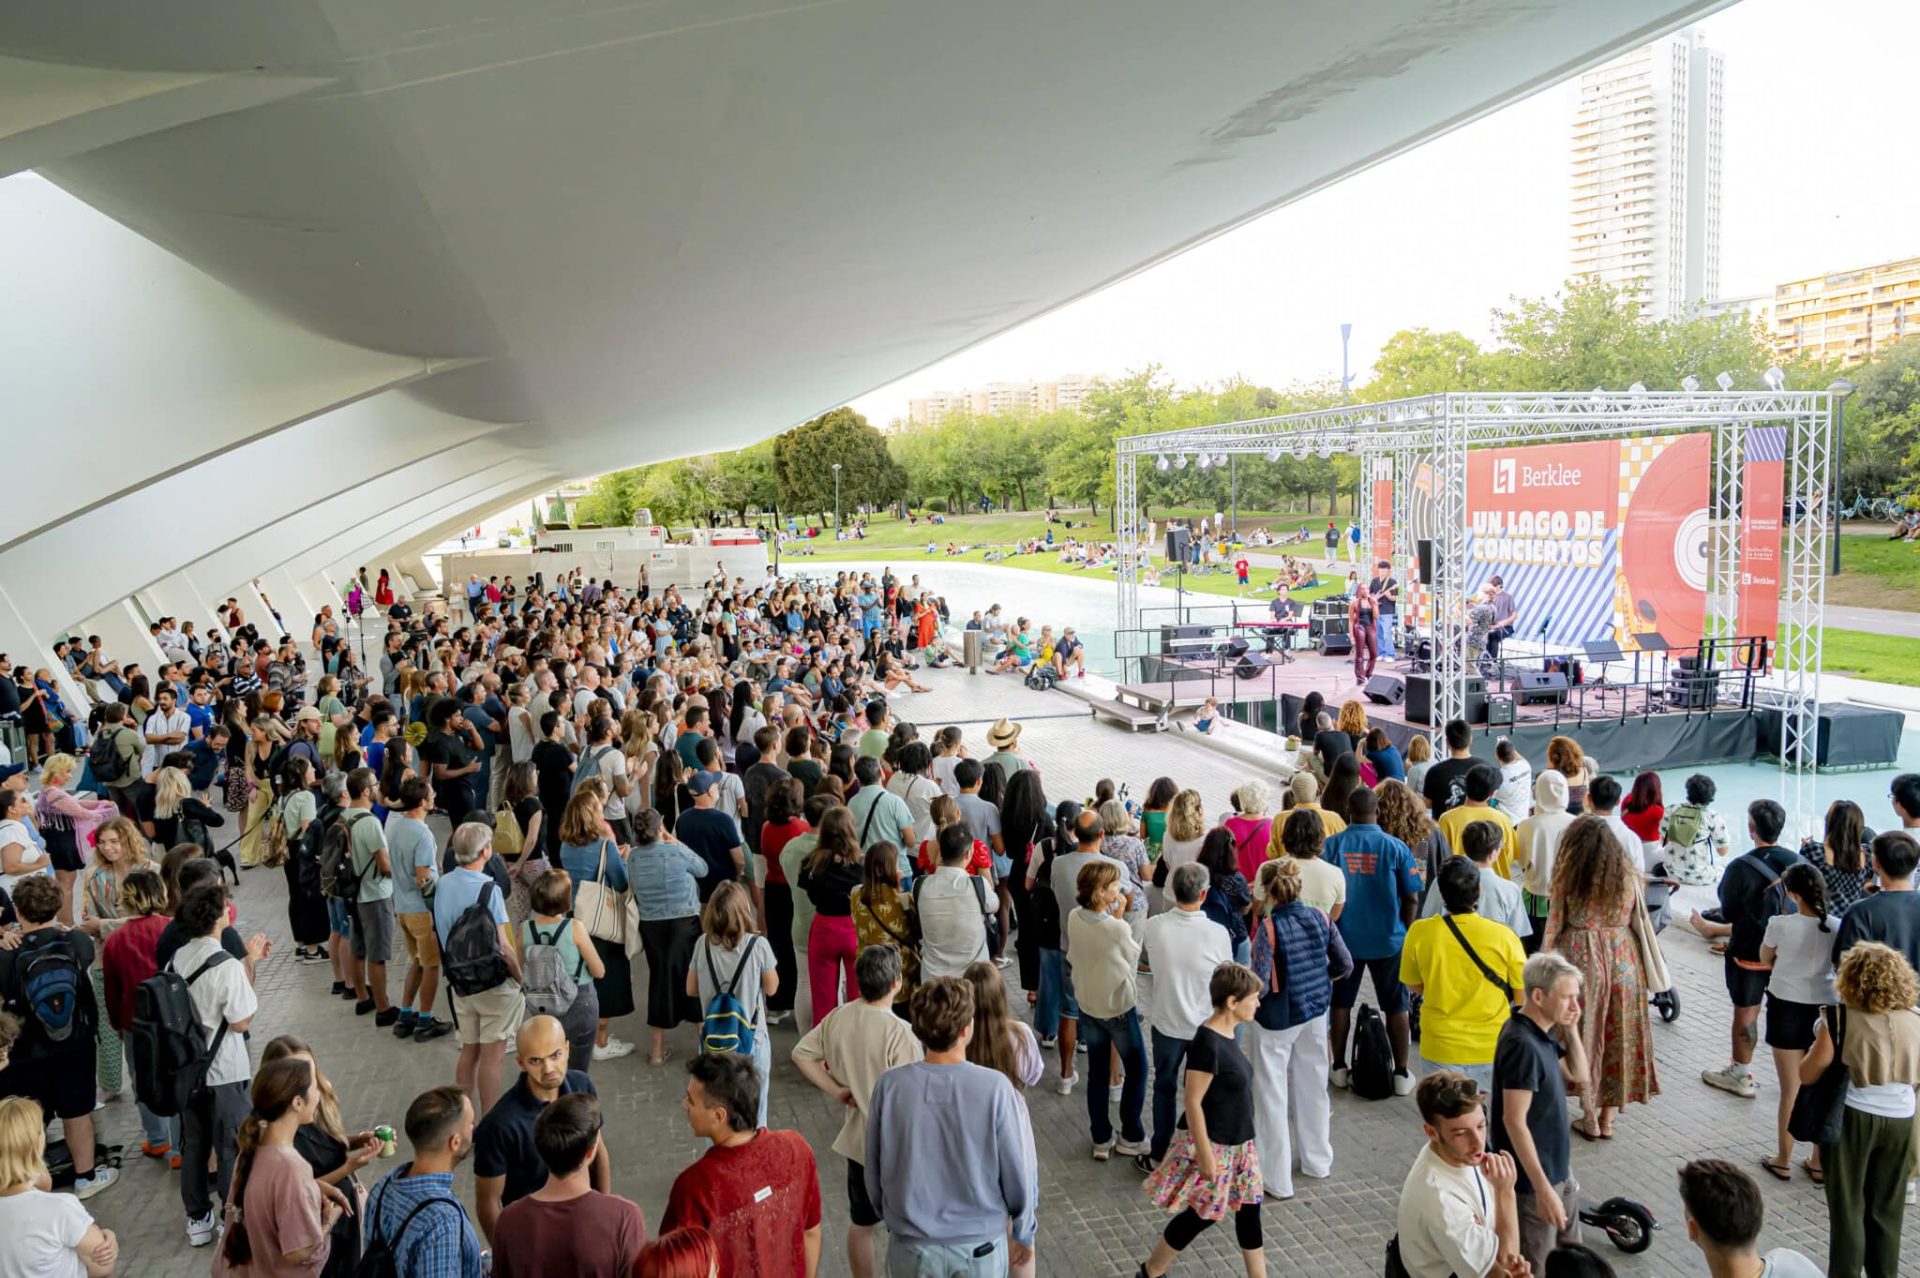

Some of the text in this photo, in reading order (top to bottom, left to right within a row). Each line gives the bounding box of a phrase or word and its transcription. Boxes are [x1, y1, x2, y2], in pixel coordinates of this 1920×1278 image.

[1522, 463, 1581, 487] Berklee
[1473, 510, 1605, 540] UN LAGO DE
[1473, 538, 1604, 567] CONCIERTOS
